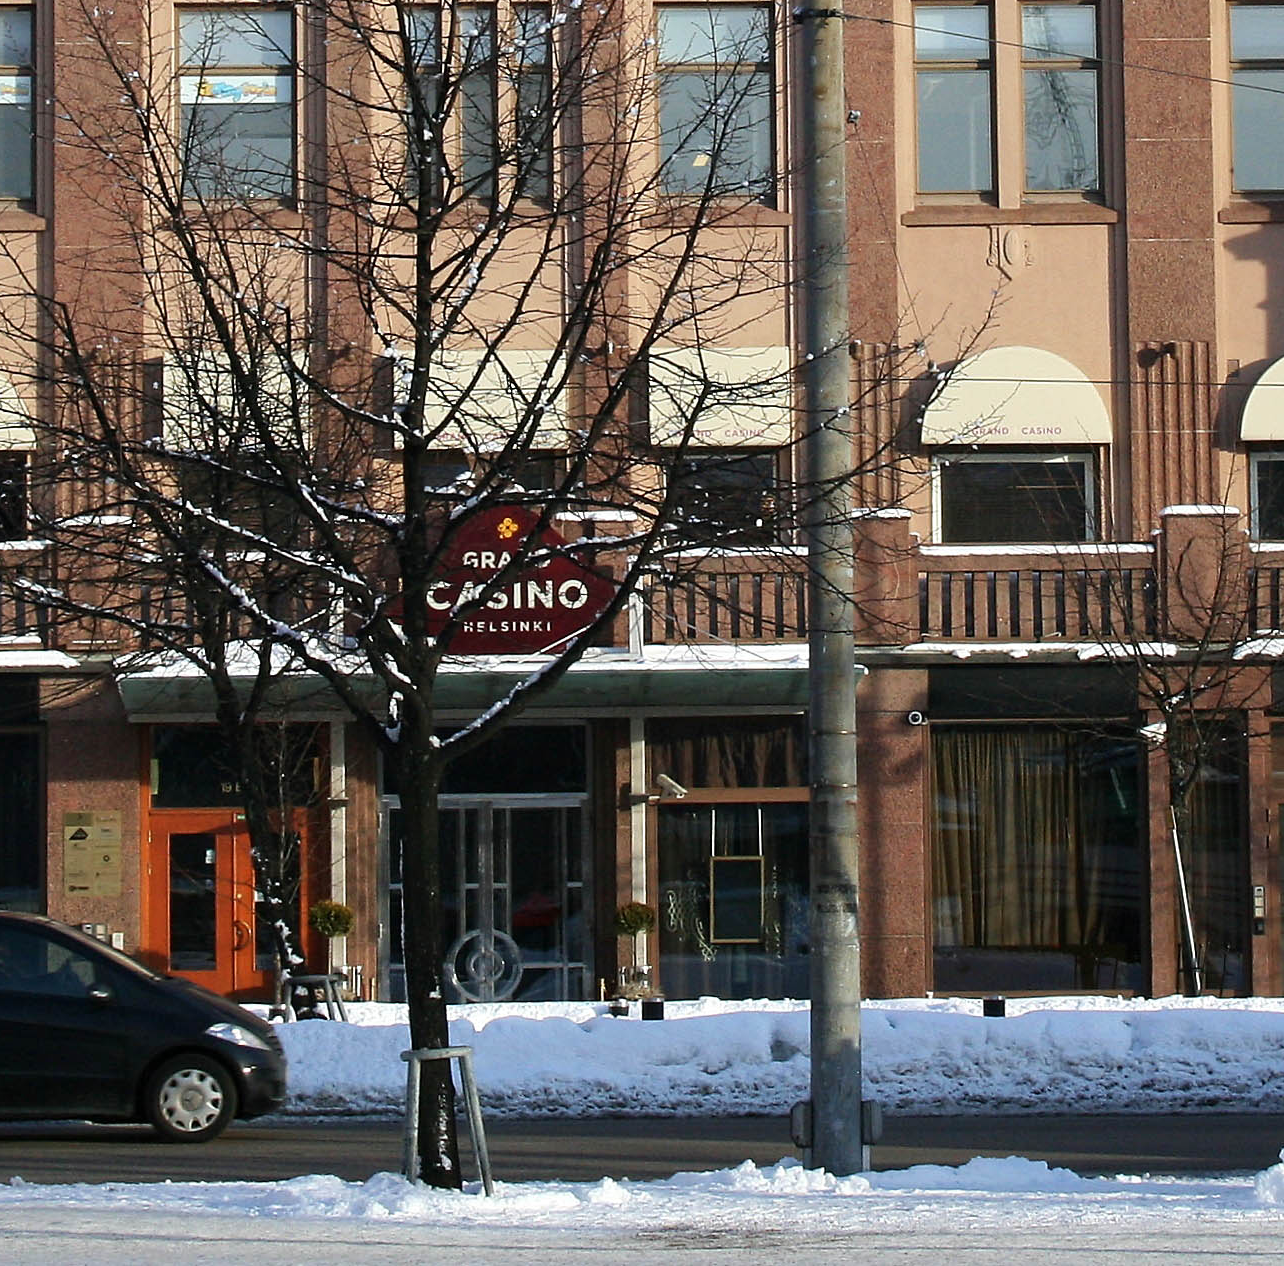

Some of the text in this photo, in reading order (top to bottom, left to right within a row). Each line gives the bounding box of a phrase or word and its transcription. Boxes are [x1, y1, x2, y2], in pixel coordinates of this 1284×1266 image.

[971, 426, 1063, 436] GRAND CASINO
[463, 620, 553, 632] HELSINKI
